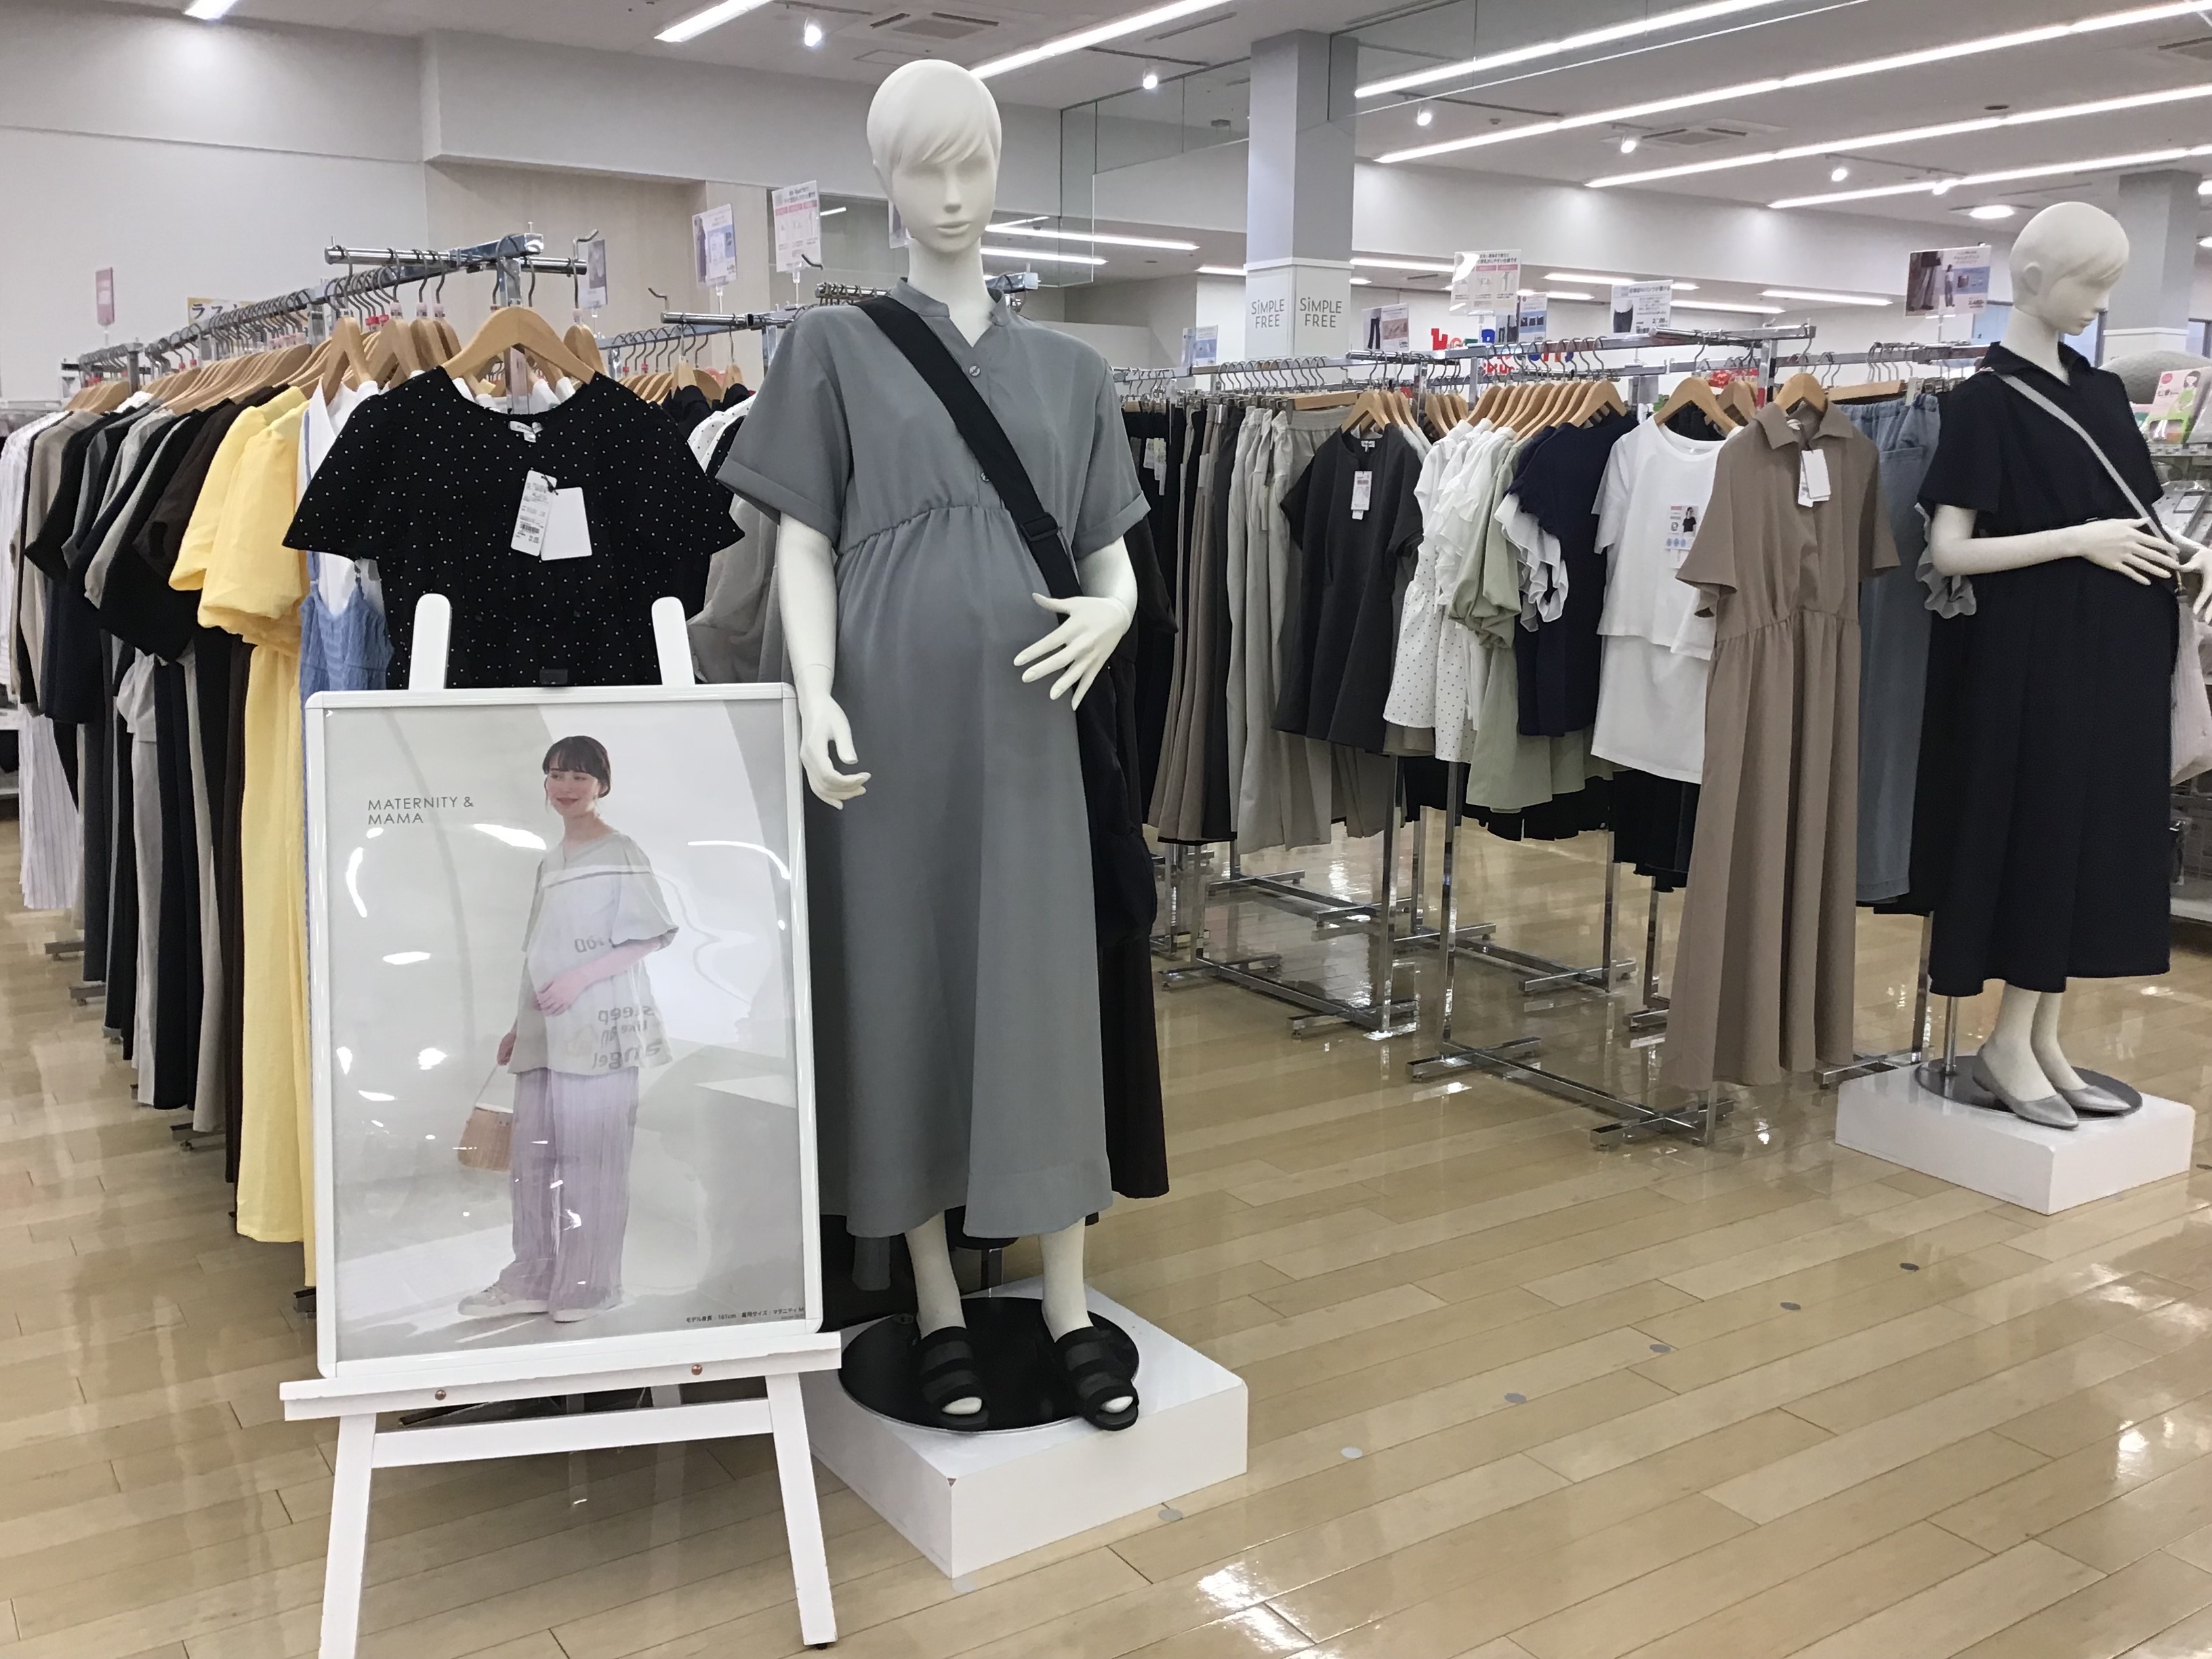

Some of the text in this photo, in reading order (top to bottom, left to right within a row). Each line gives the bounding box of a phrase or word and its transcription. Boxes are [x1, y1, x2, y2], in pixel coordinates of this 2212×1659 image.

[1255, 314, 1280, 329] FREE
[1305, 313, 1336, 328] FREE
[368, 796, 474, 811] MATERNITY &
[368, 813, 424, 825] MAMA
